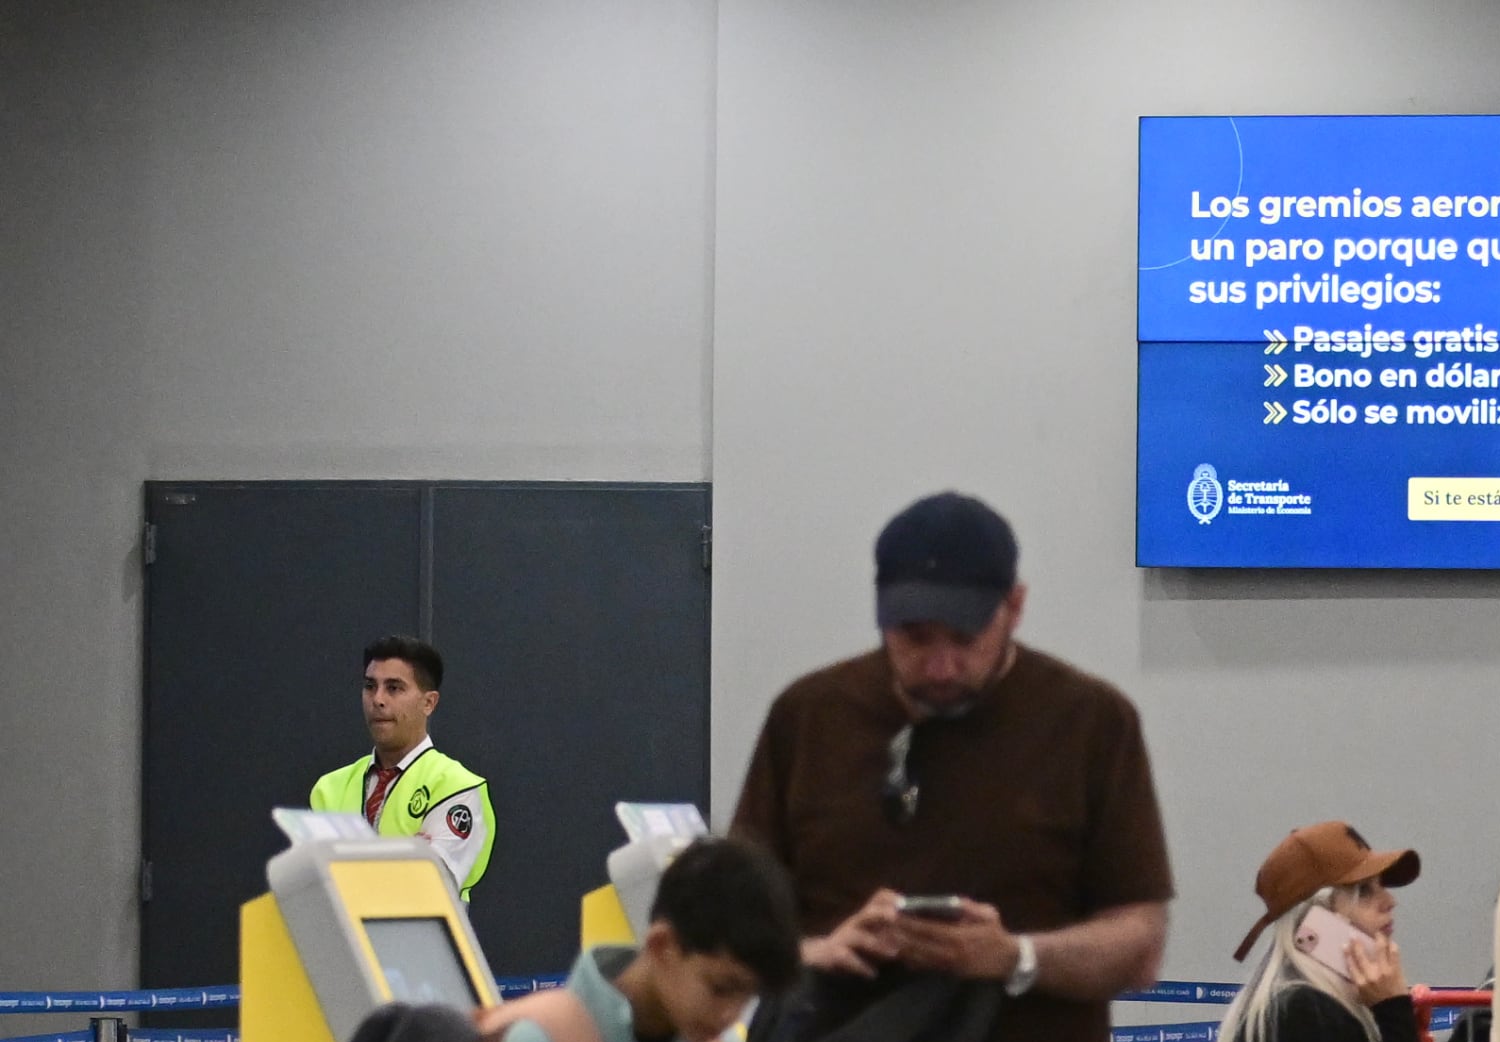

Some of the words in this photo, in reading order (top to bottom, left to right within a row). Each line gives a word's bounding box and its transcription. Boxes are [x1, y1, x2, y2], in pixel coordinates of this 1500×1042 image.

[1191, 190, 1249, 218] Los
[1259, 188, 1402, 223] gremios
[1191, 238, 1235, 261] un
[1245, 238, 1324, 267] paro
[1333, 238, 1458, 267] porque
[1189, 280, 1246, 304] sus
[1256, 272, 1441, 309] privilegios:
[1293, 324, 1407, 357] Pasajes
[1413, 324, 1499, 357] gratis
[1294, 363, 1373, 388] Bono
[1380, 368, 1417, 388] en
[1292, 398, 1357, 424] Sólo
[1364, 404, 1398, 425] se
[1228, 493, 1243, 505] de
[1244, 493, 1311, 508] Transporte
[1424, 490, 1440, 506] Si
[1445, 491, 1462, 506] te
